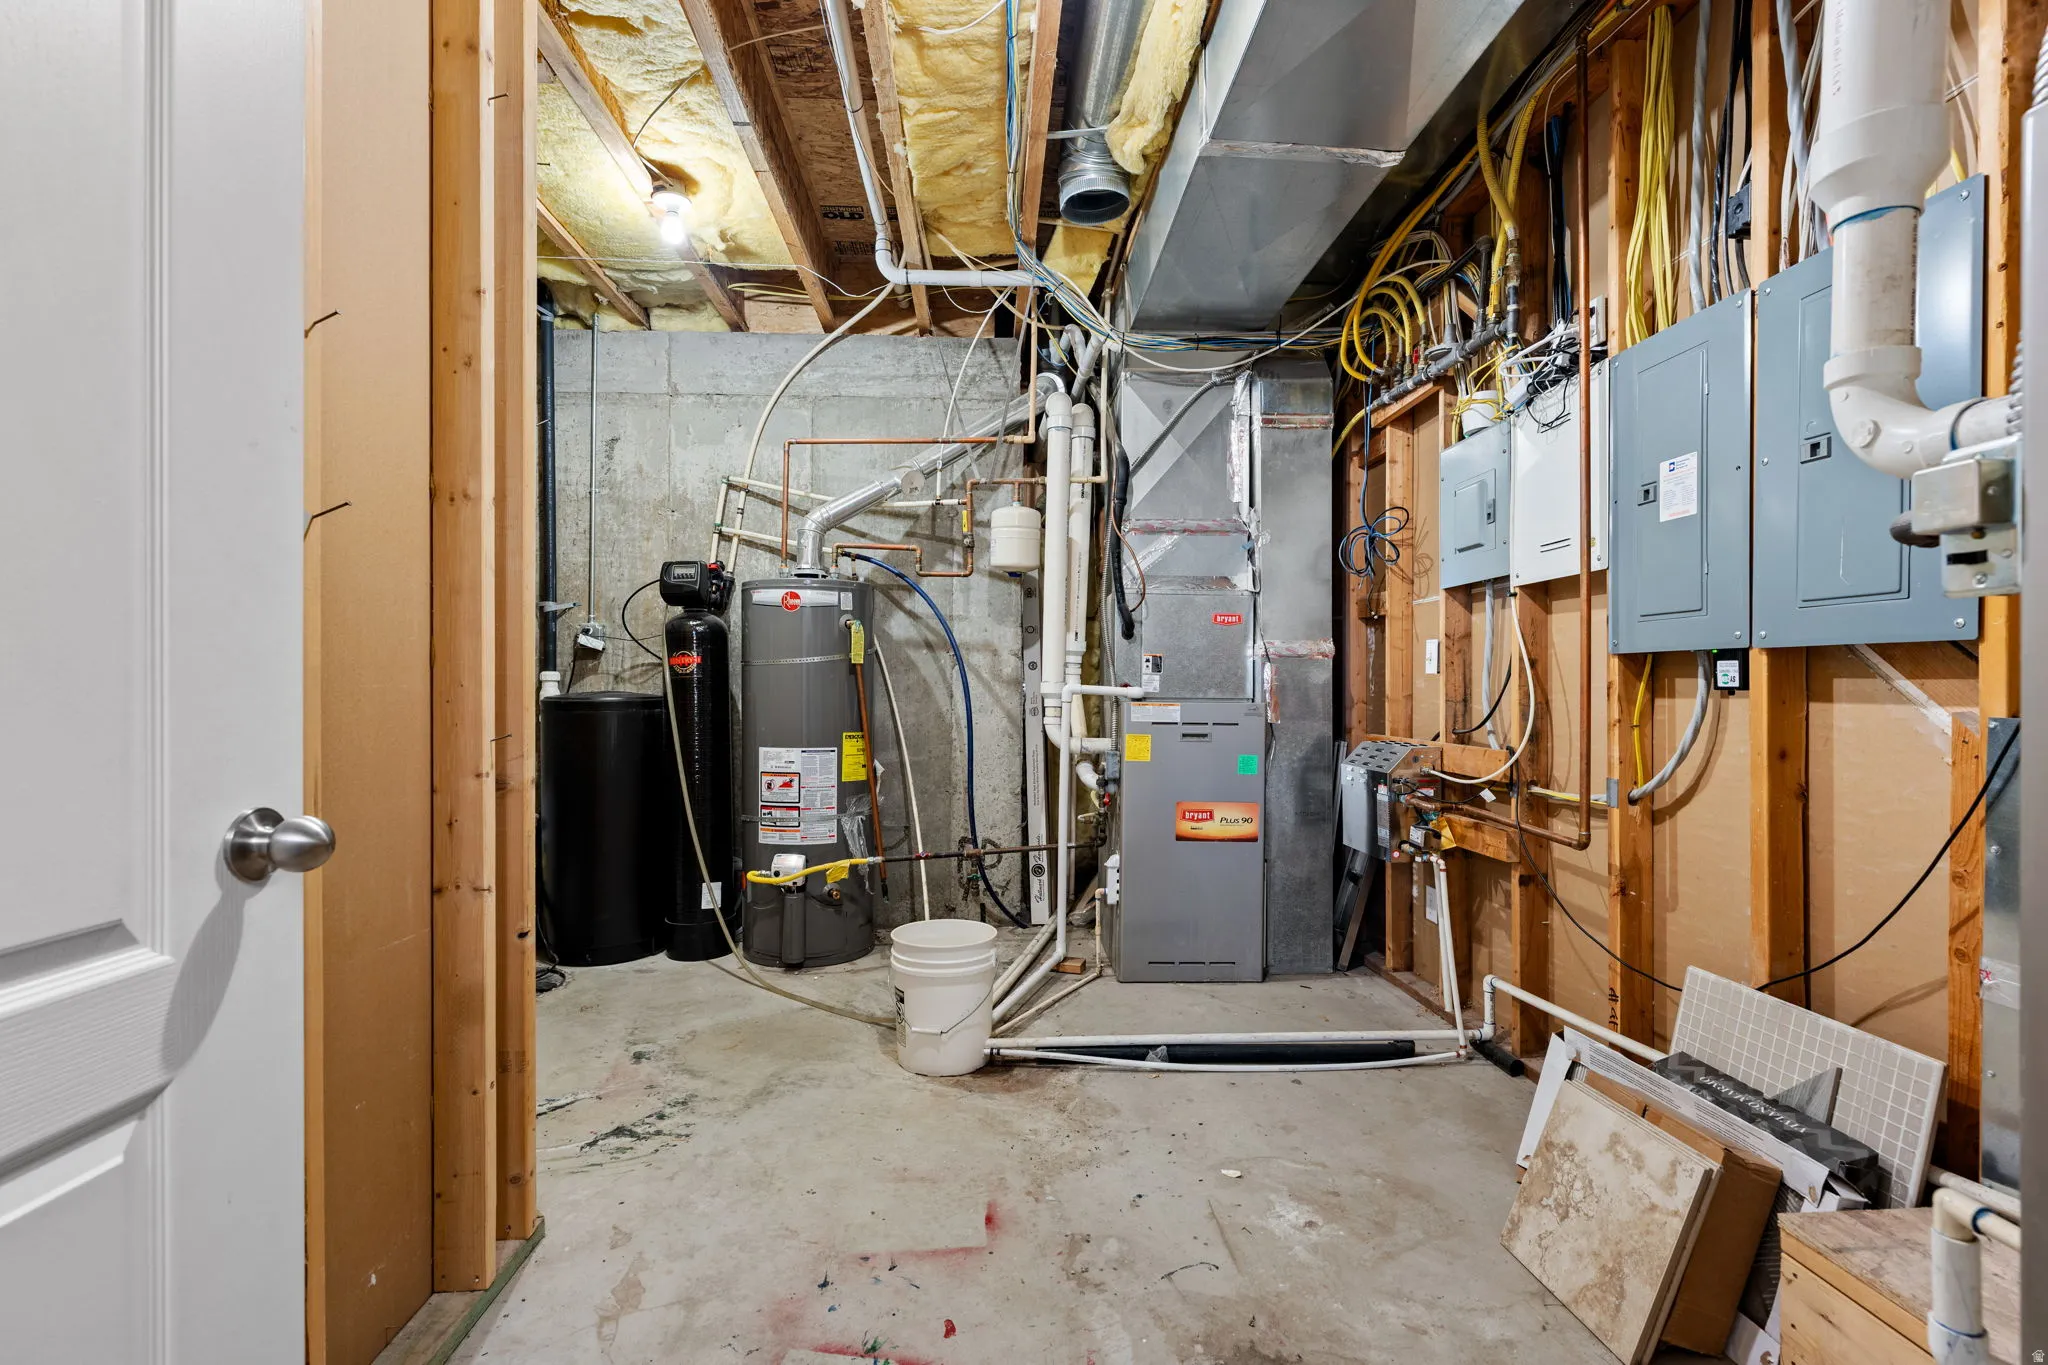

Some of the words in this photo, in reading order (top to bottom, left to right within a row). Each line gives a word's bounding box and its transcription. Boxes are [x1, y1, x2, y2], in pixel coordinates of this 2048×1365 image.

[1216, 615, 1239, 623] bryant
[1185, 811, 1210, 820] bryant
[1240, 816, 1254, 824] 90
